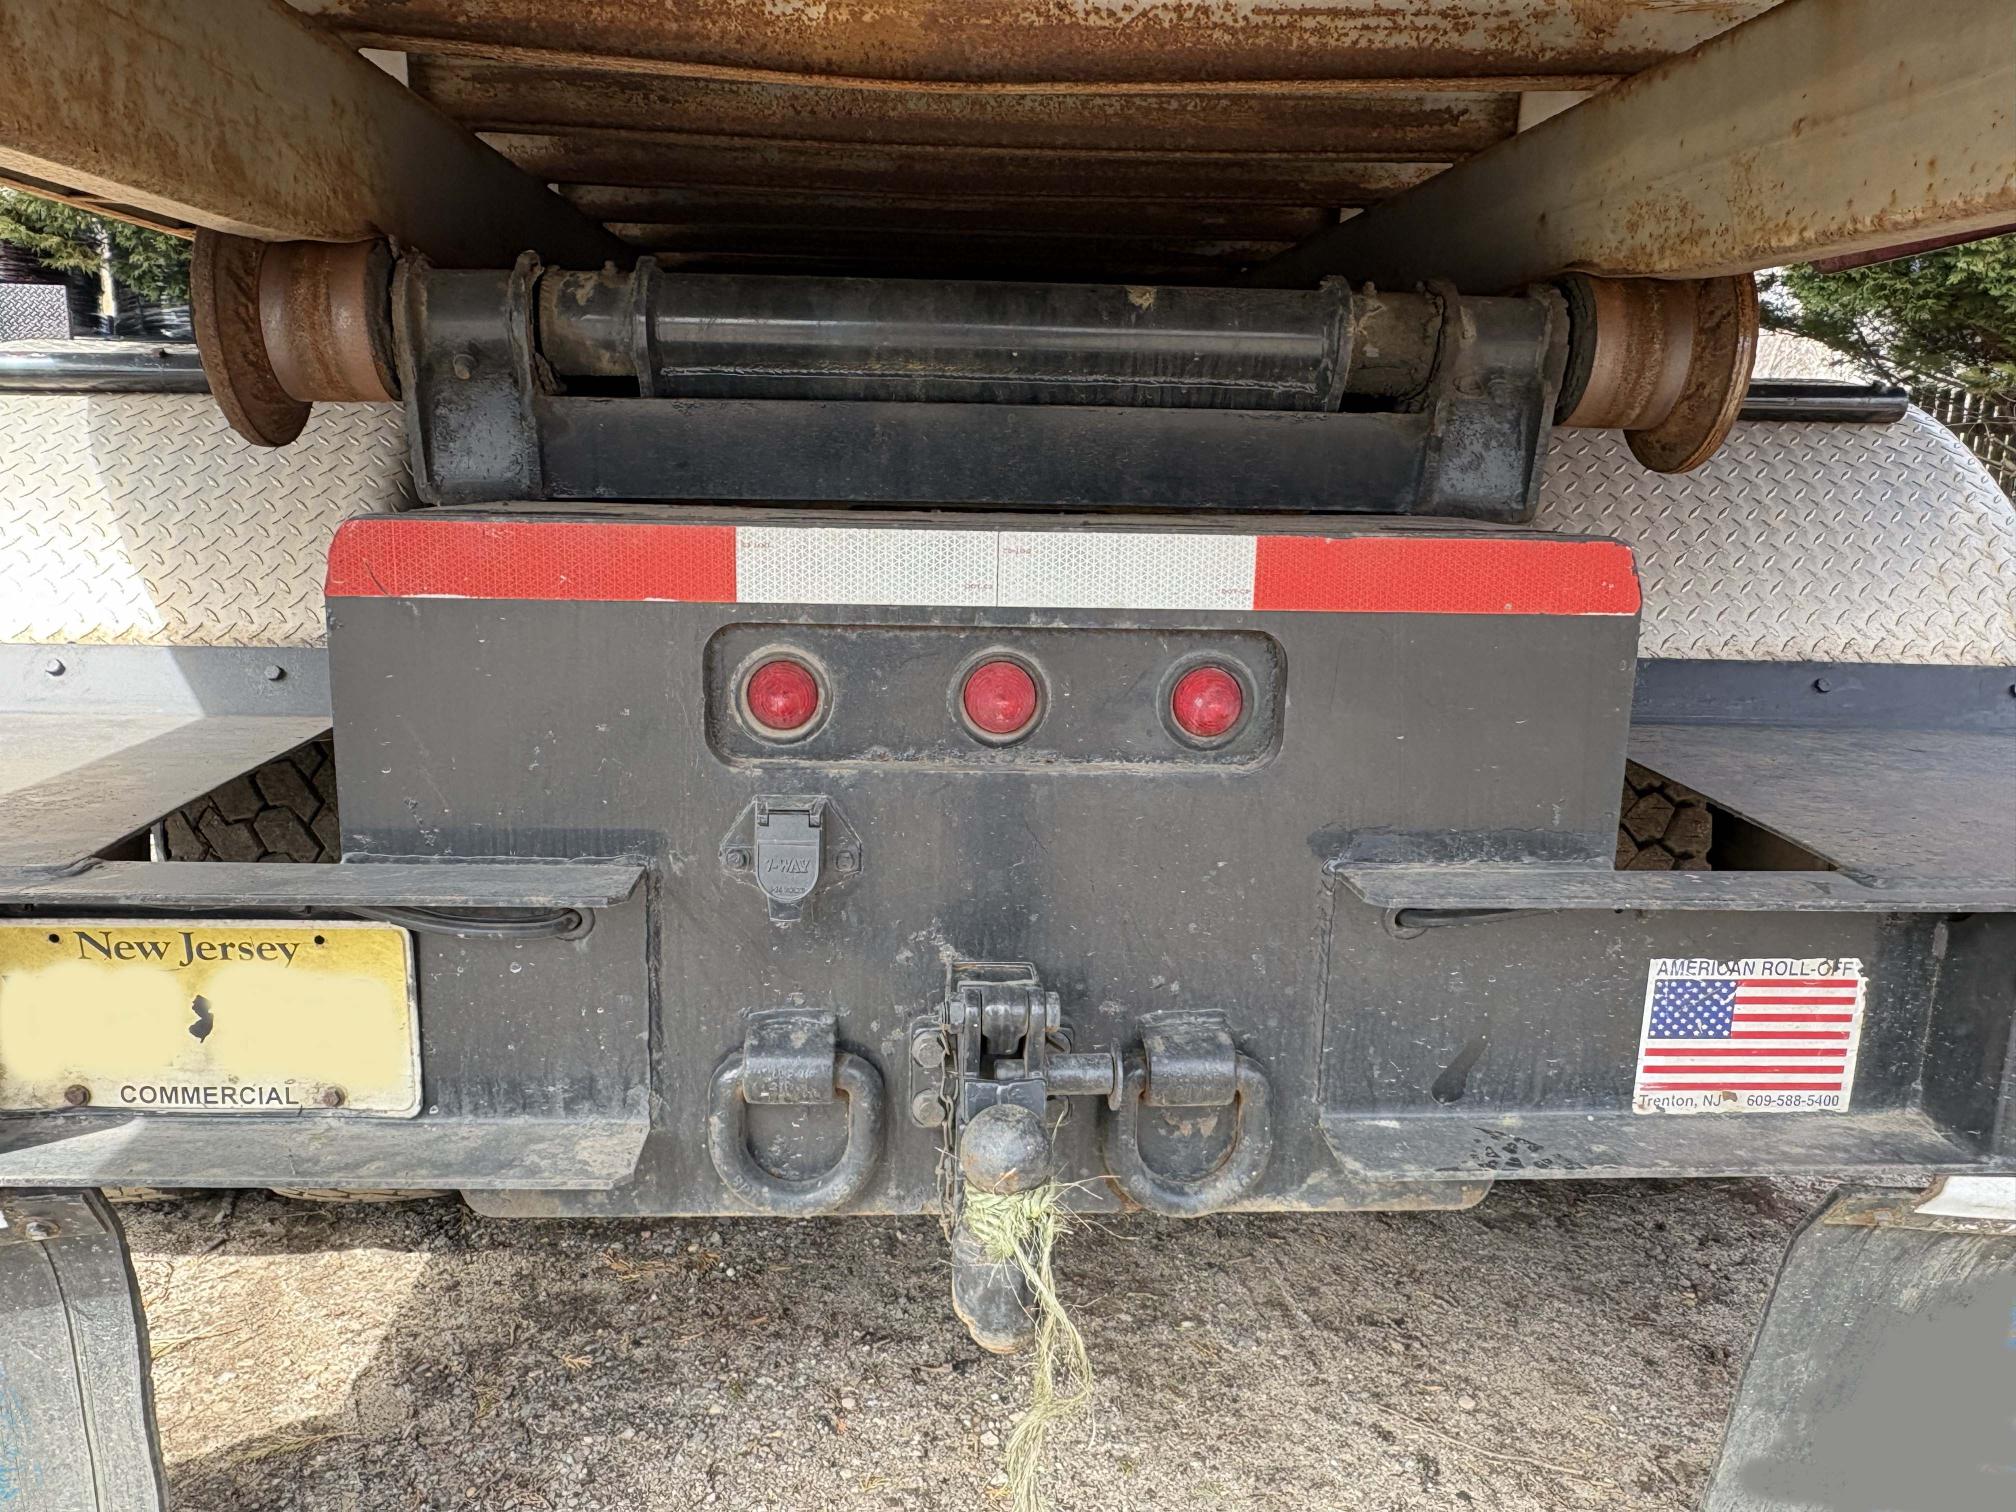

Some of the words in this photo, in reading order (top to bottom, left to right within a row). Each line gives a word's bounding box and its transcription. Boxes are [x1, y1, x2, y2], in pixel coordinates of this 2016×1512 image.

[766, 857, 811, 874] 7-WAY
[74, 931, 171, 961] New
[178, 931, 300, 967] Jersey
[1656, 960, 1755, 976] AMERICAN
[120, 1085, 299, 1106] COMMERCIAL
[1639, 1094, 1698, 1108] Trenton,
[1703, 1094, 1721, 1106] NJ
[1747, 1094, 1840, 1106] 609-588-5400
